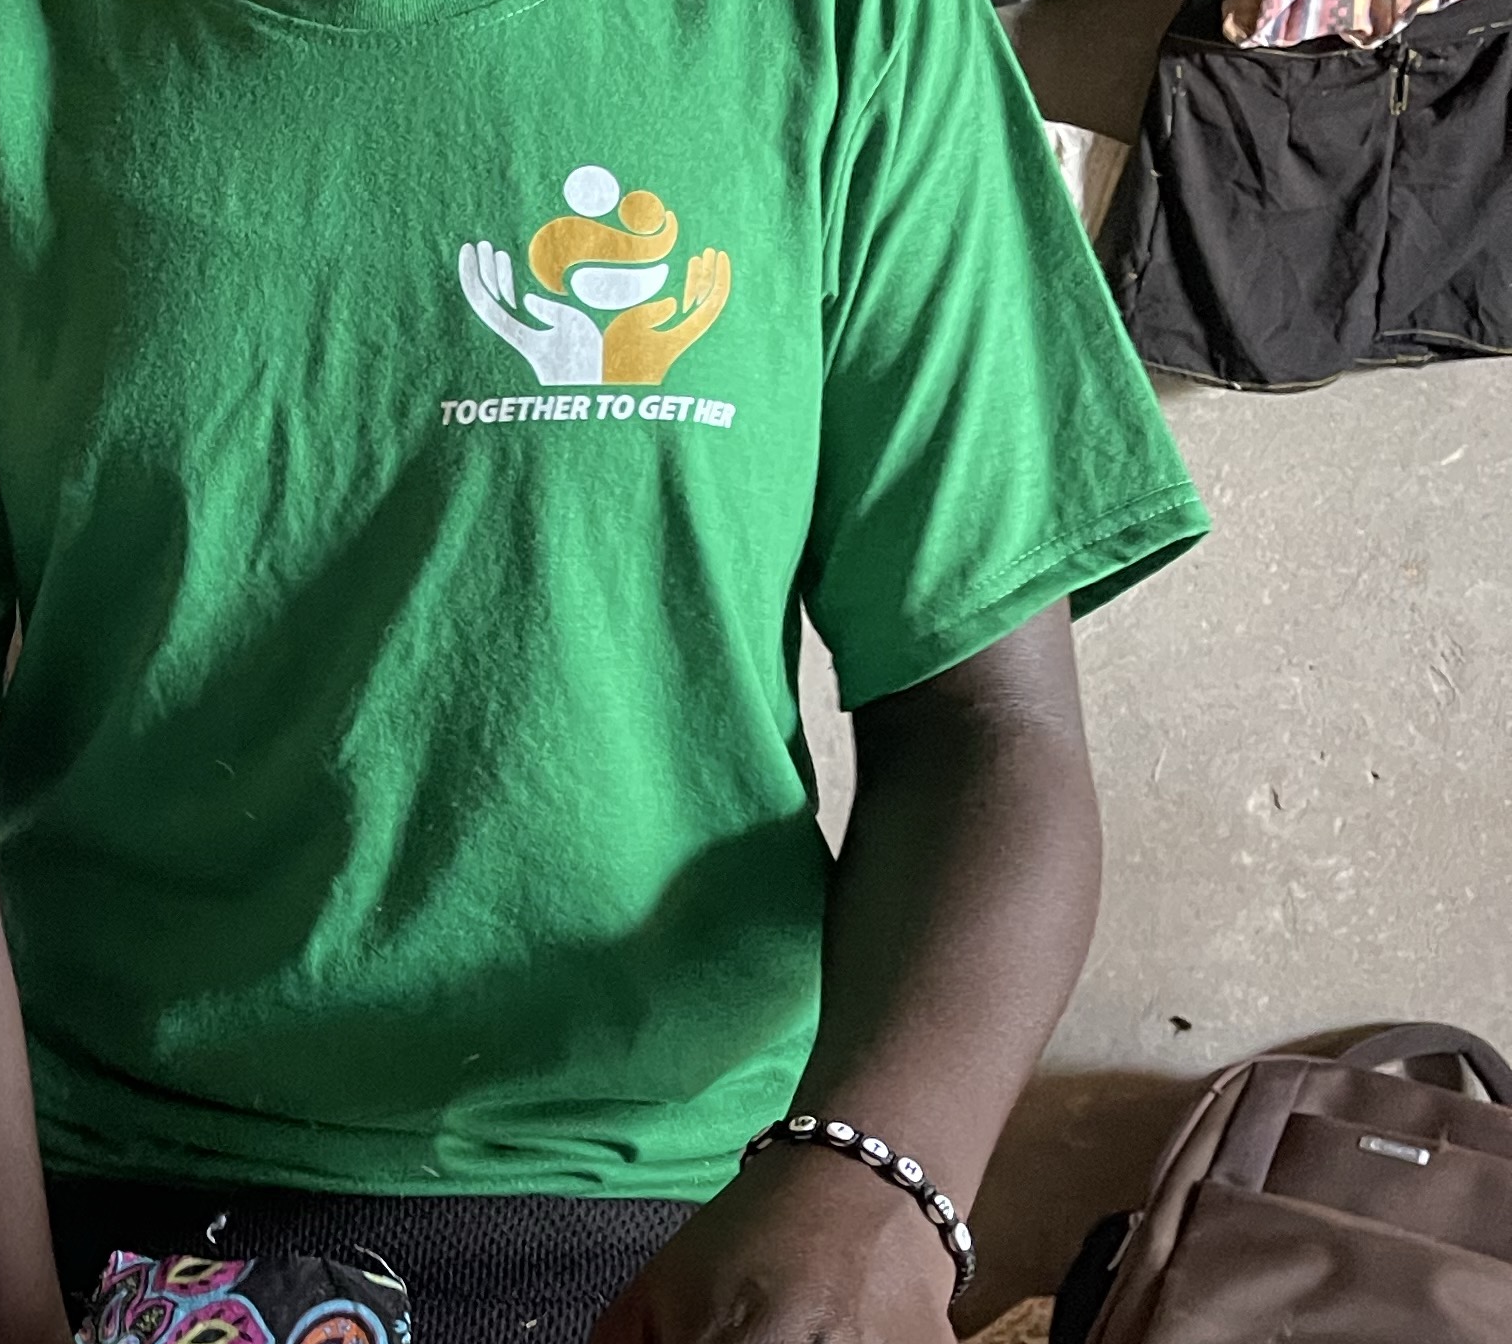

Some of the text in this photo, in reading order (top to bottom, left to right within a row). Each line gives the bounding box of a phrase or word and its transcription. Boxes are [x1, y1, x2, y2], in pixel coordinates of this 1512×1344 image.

[441, 394, 737, 429] TOGETHER TO GET HER
